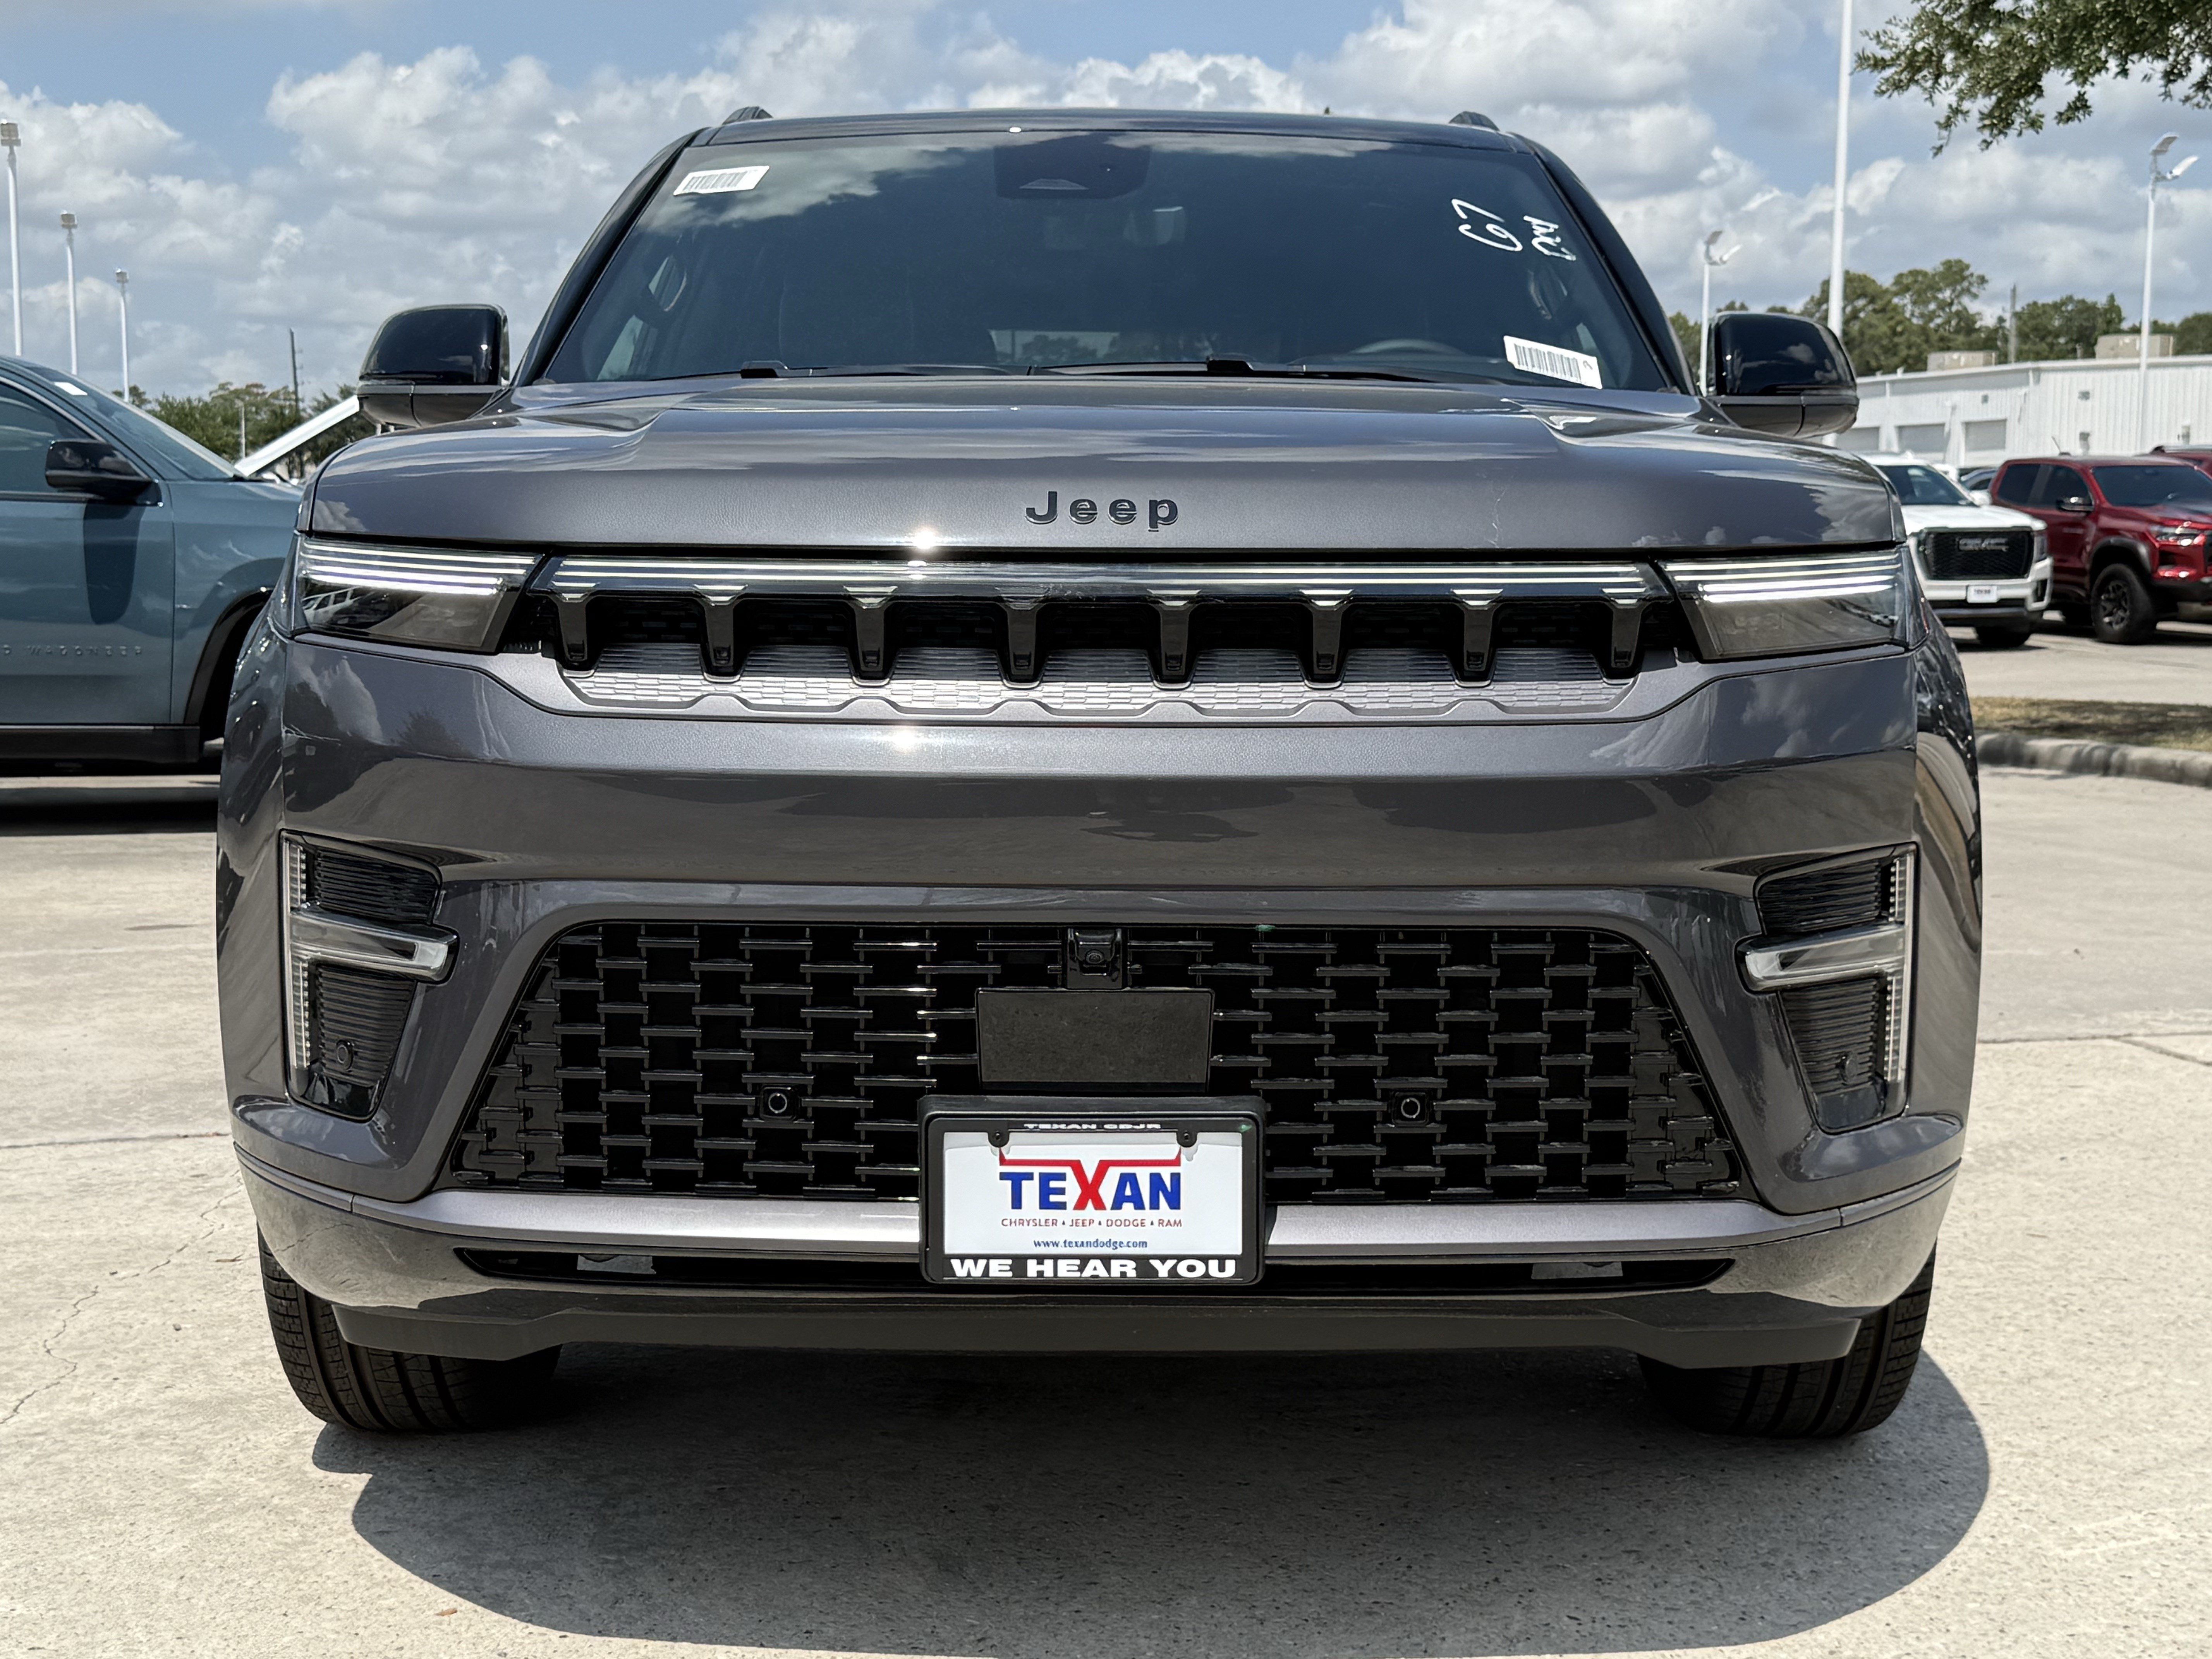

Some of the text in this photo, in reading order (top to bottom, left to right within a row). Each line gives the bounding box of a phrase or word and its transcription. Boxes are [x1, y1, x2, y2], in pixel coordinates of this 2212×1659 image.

[1025, 491, 1178, 532] Jeep
[999, 1159, 1182, 1211] TEXAN
[1001, 1218, 1182, 1227] CHRYSLER JEEP DODGE RAM
[1033, 1238, 1148, 1250] www.texandodge.com
[951, 1259, 1237, 1278] WE HEAR YOU
